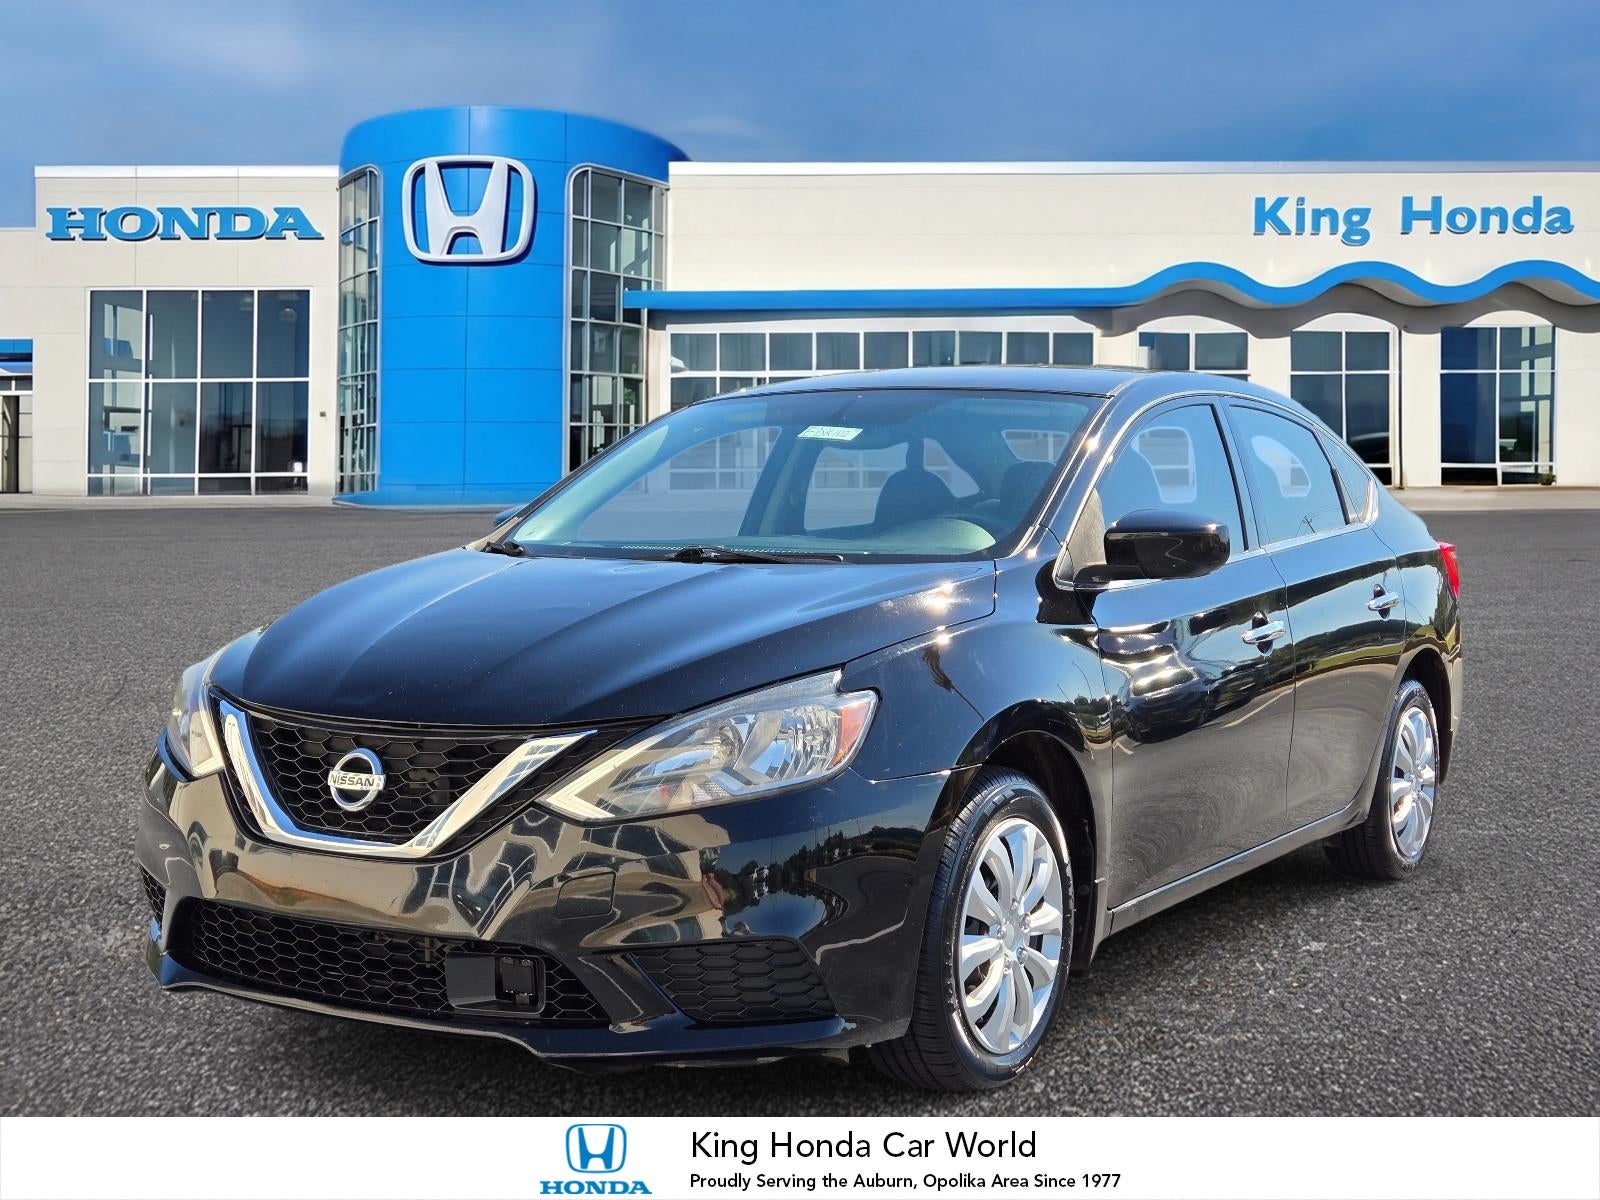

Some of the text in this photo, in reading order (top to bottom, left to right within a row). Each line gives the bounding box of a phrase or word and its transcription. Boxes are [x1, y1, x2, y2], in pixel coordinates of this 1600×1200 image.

[45, 206, 325, 242] HONDA
[1253, 195, 1575, 247] King Honda
[330, 774, 376, 787] NISSAN
